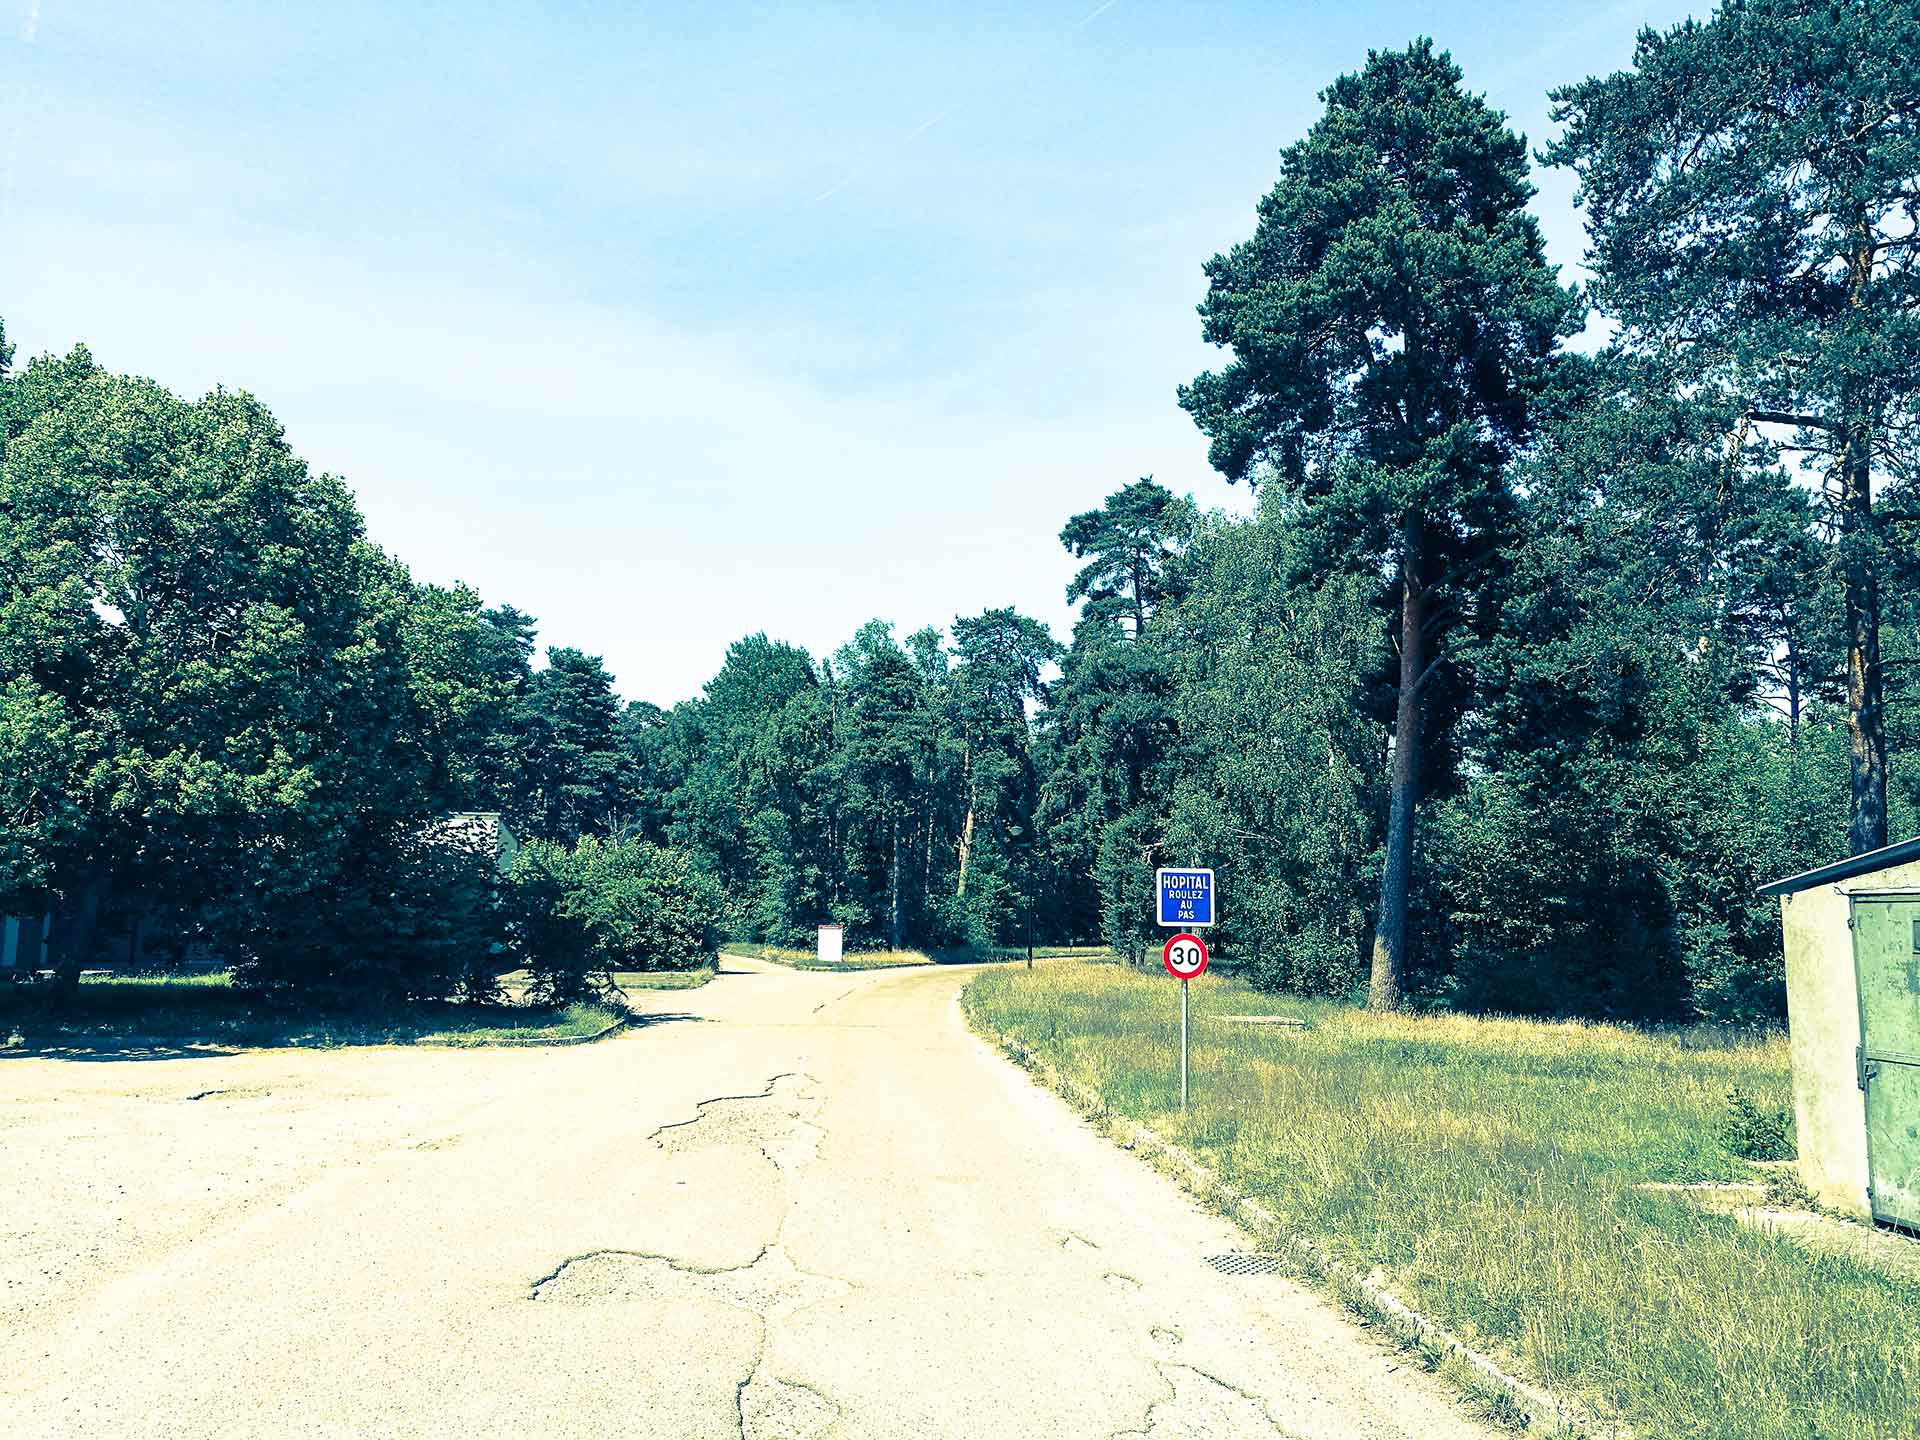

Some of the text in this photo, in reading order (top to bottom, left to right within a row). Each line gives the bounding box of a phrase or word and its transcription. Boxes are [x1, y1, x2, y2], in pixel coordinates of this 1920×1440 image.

[1163, 875, 1209, 889] HOPITAL
[1169, 890, 1203, 899] ROULEZ
[1180, 900, 1192, 909] AU
[1178, 910, 1194, 919] PAS
[1172, 947, 1199, 965] 30
